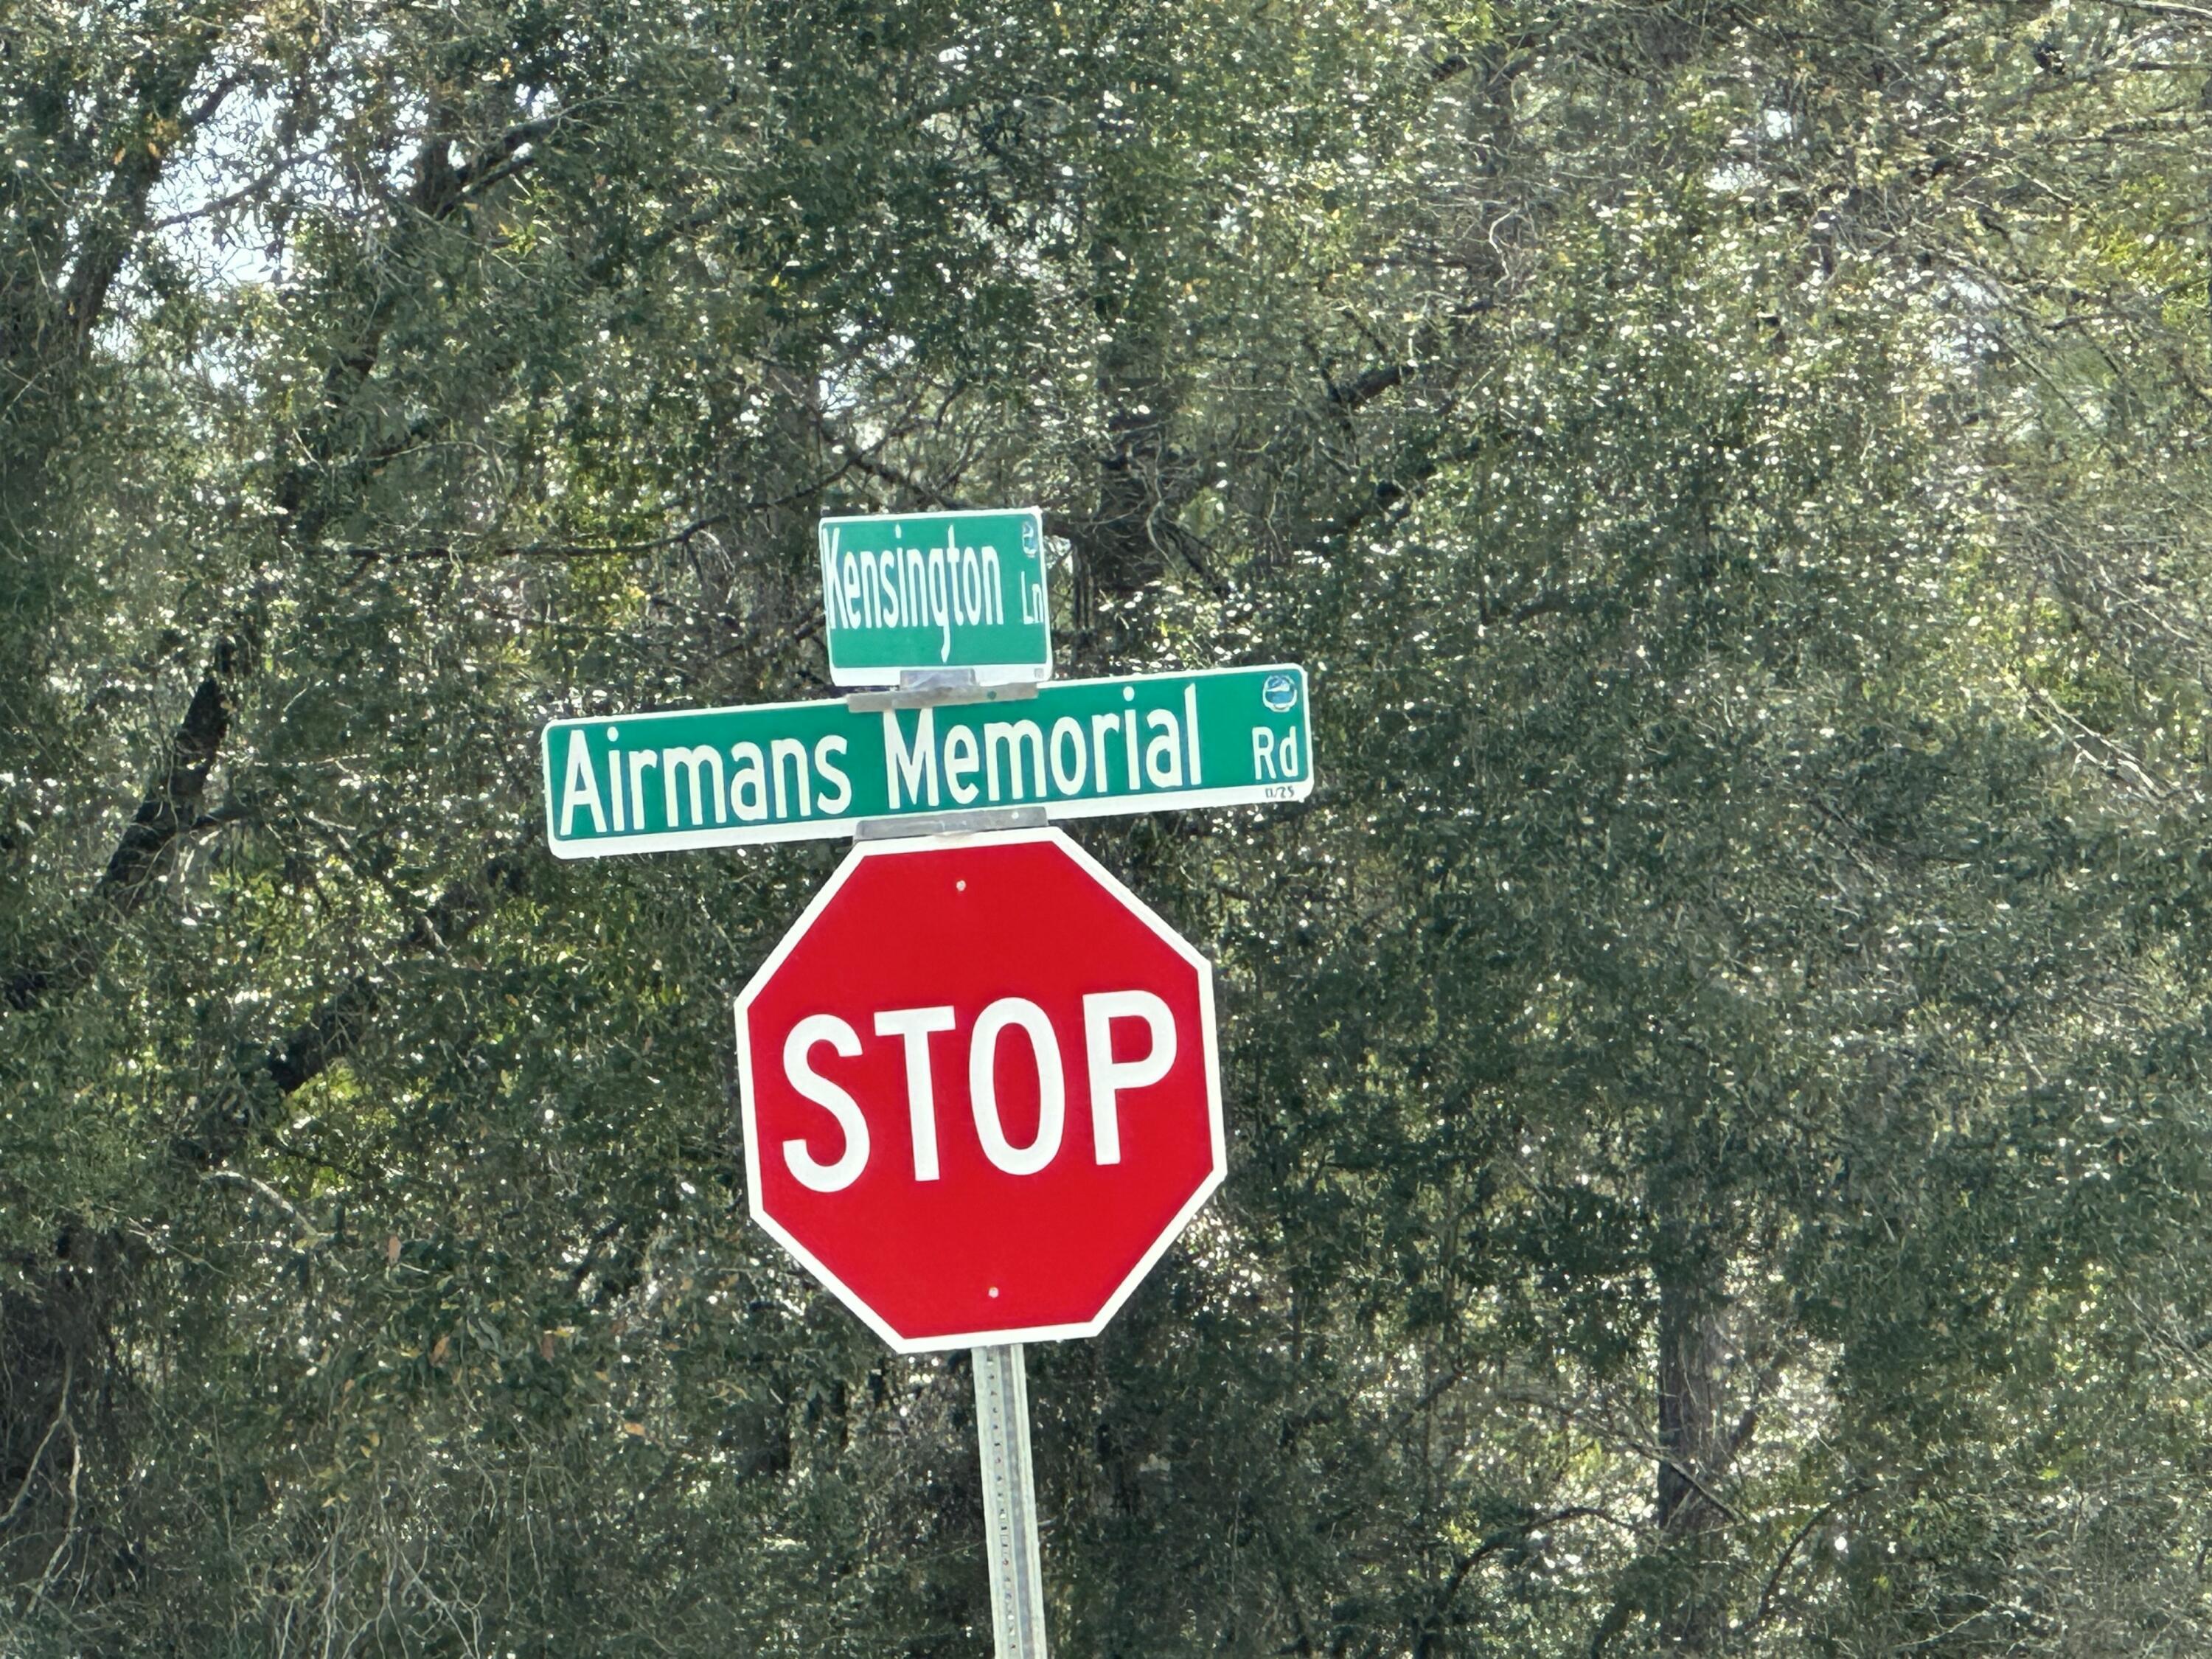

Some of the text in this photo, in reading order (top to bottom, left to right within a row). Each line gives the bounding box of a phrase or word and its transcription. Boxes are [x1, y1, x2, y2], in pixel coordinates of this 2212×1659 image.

[822, 524, 1044, 663] Kensington Ln
[559, 682, 1298, 835] Airmans Memorial Rd
[782, 990, 1178, 1192] STOP
